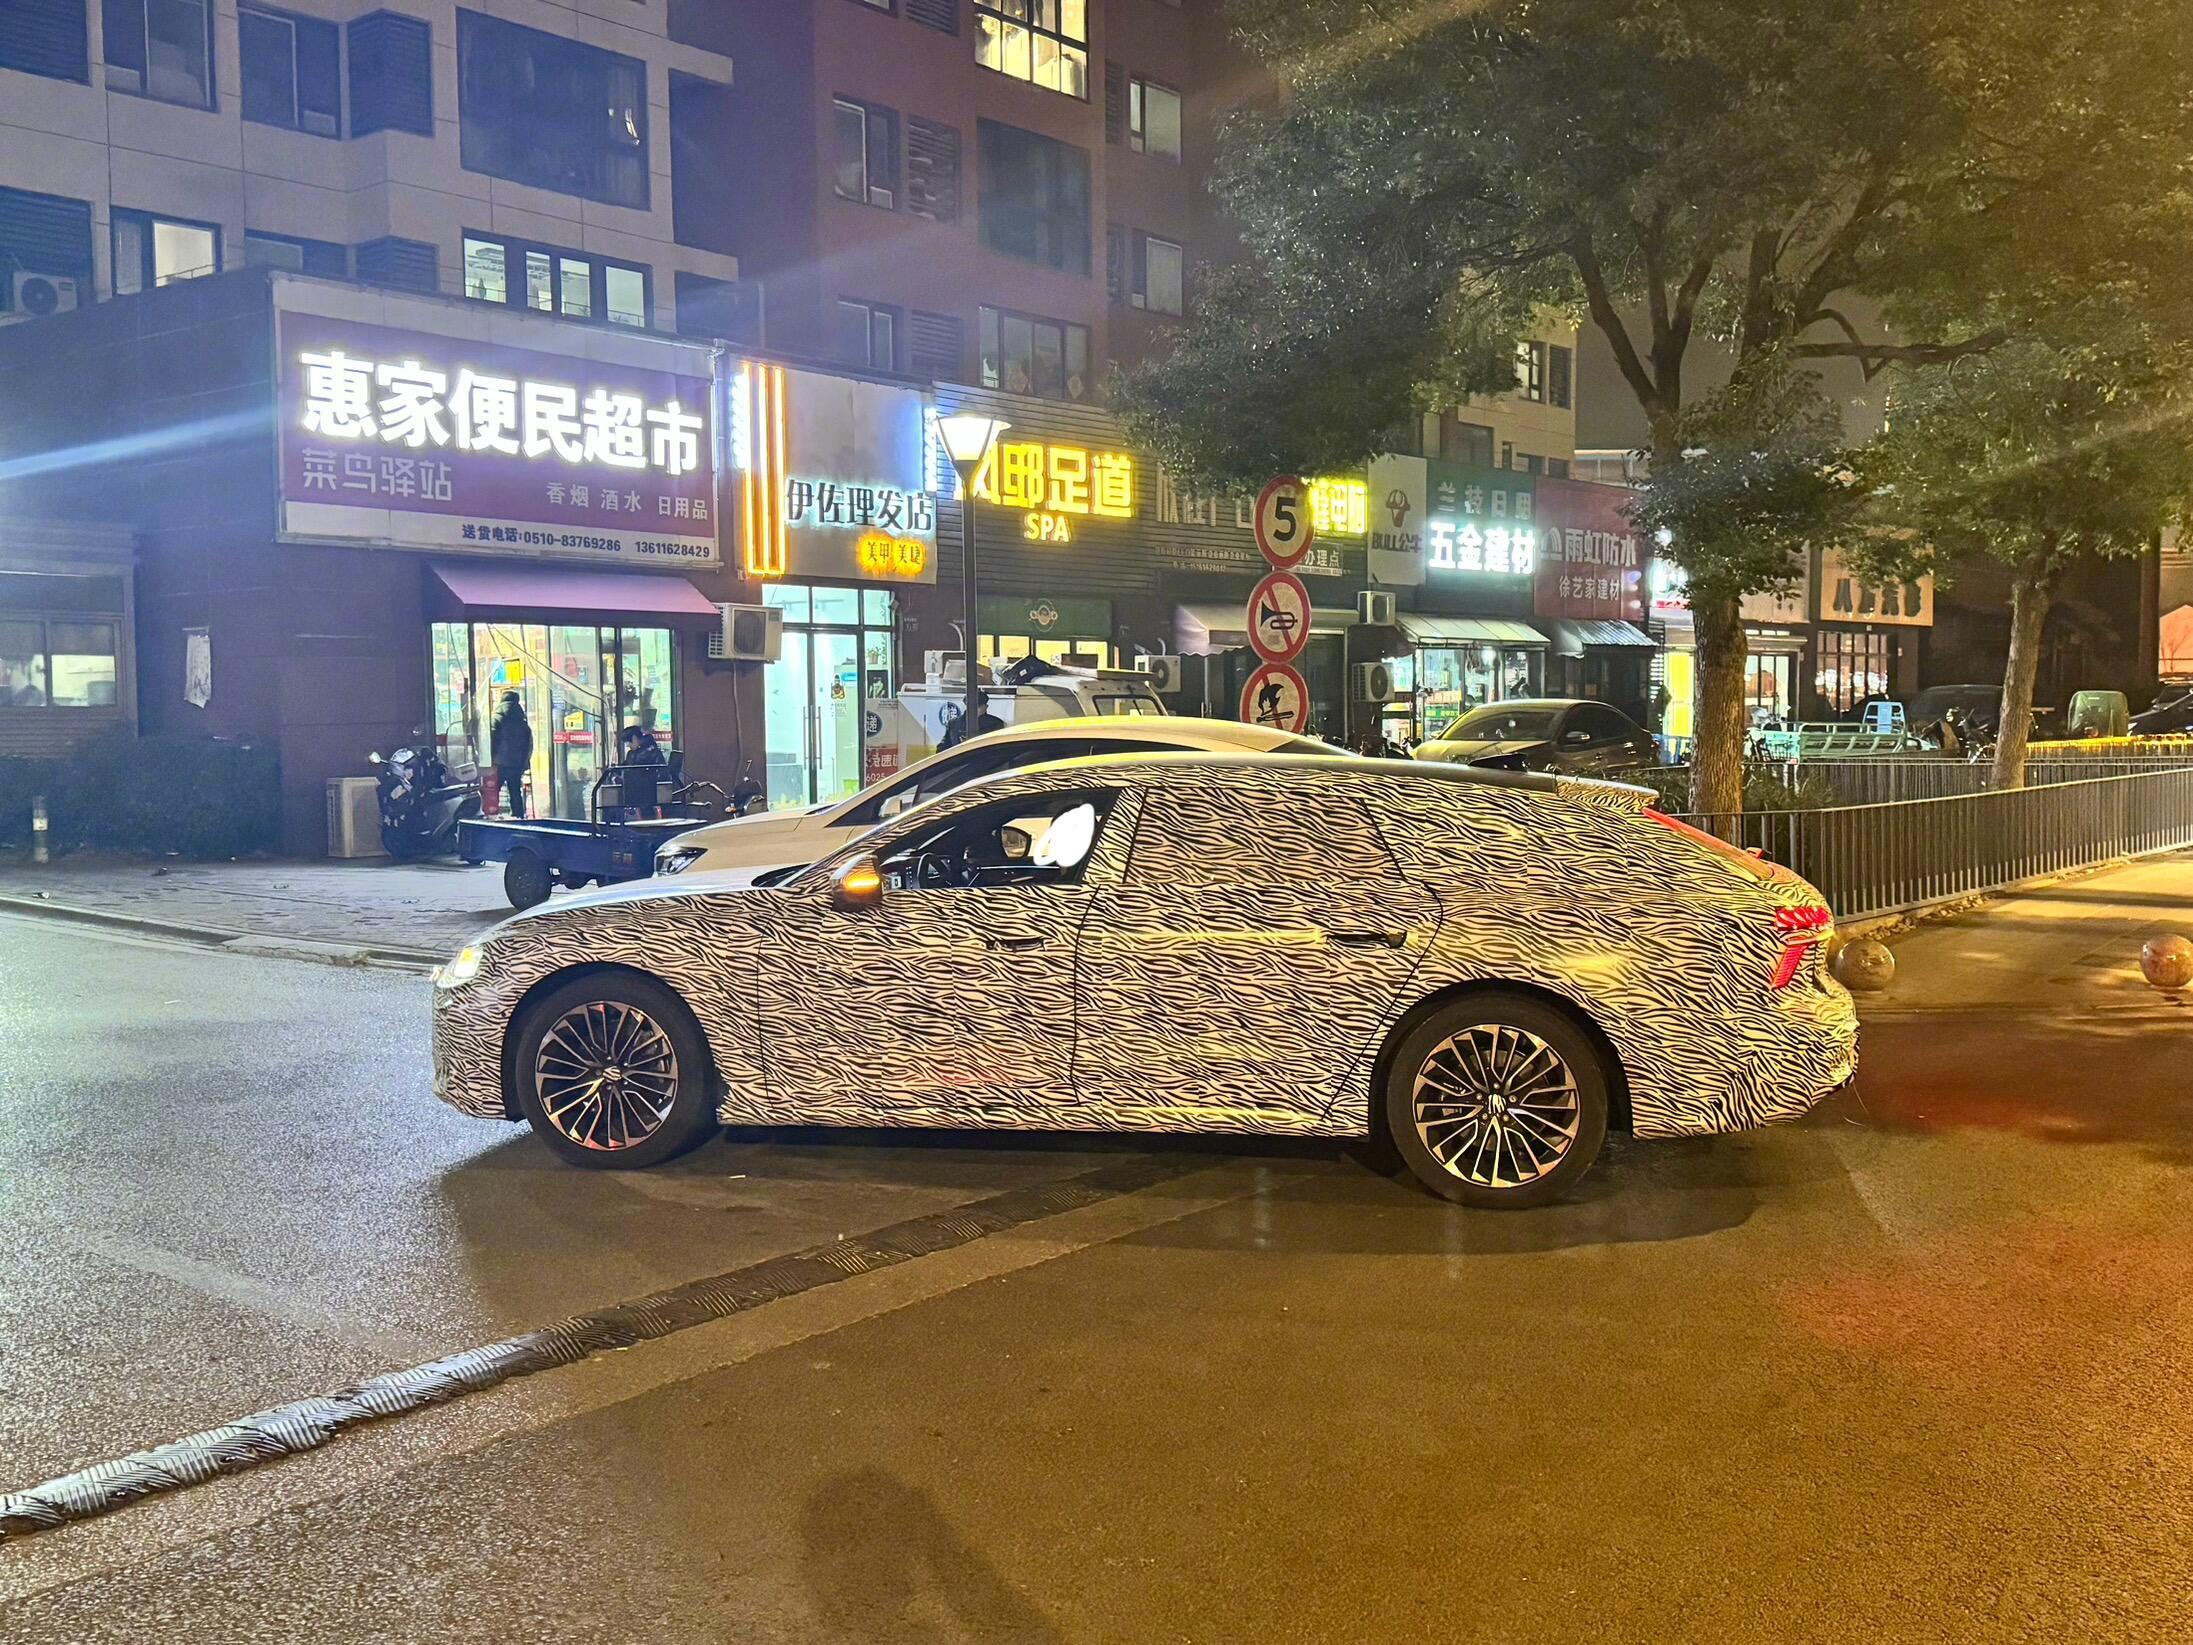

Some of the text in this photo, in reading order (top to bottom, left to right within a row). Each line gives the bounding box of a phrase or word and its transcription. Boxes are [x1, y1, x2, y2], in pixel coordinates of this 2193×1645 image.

[300, 352, 703, 476] 惠家便民超市
[302, 448, 452, 501] 菜鸟驿站
[547, 482, 708, 520] 香烟 酒水 日用品
[786, 480, 932, 530] 伊佐理发店
[1273, 496, 1296, 541] 5
[1024, 513, 1071, 543] SPA
[1428, 521, 1536, 574] 五金建材
[1565, 528, 1637, 567] 雨虹防水
[635, 541, 710, 557] 13611628429
[867, 541, 889, 563] 美甲
[1559, 576, 1621, 601] 徐艺家建材
